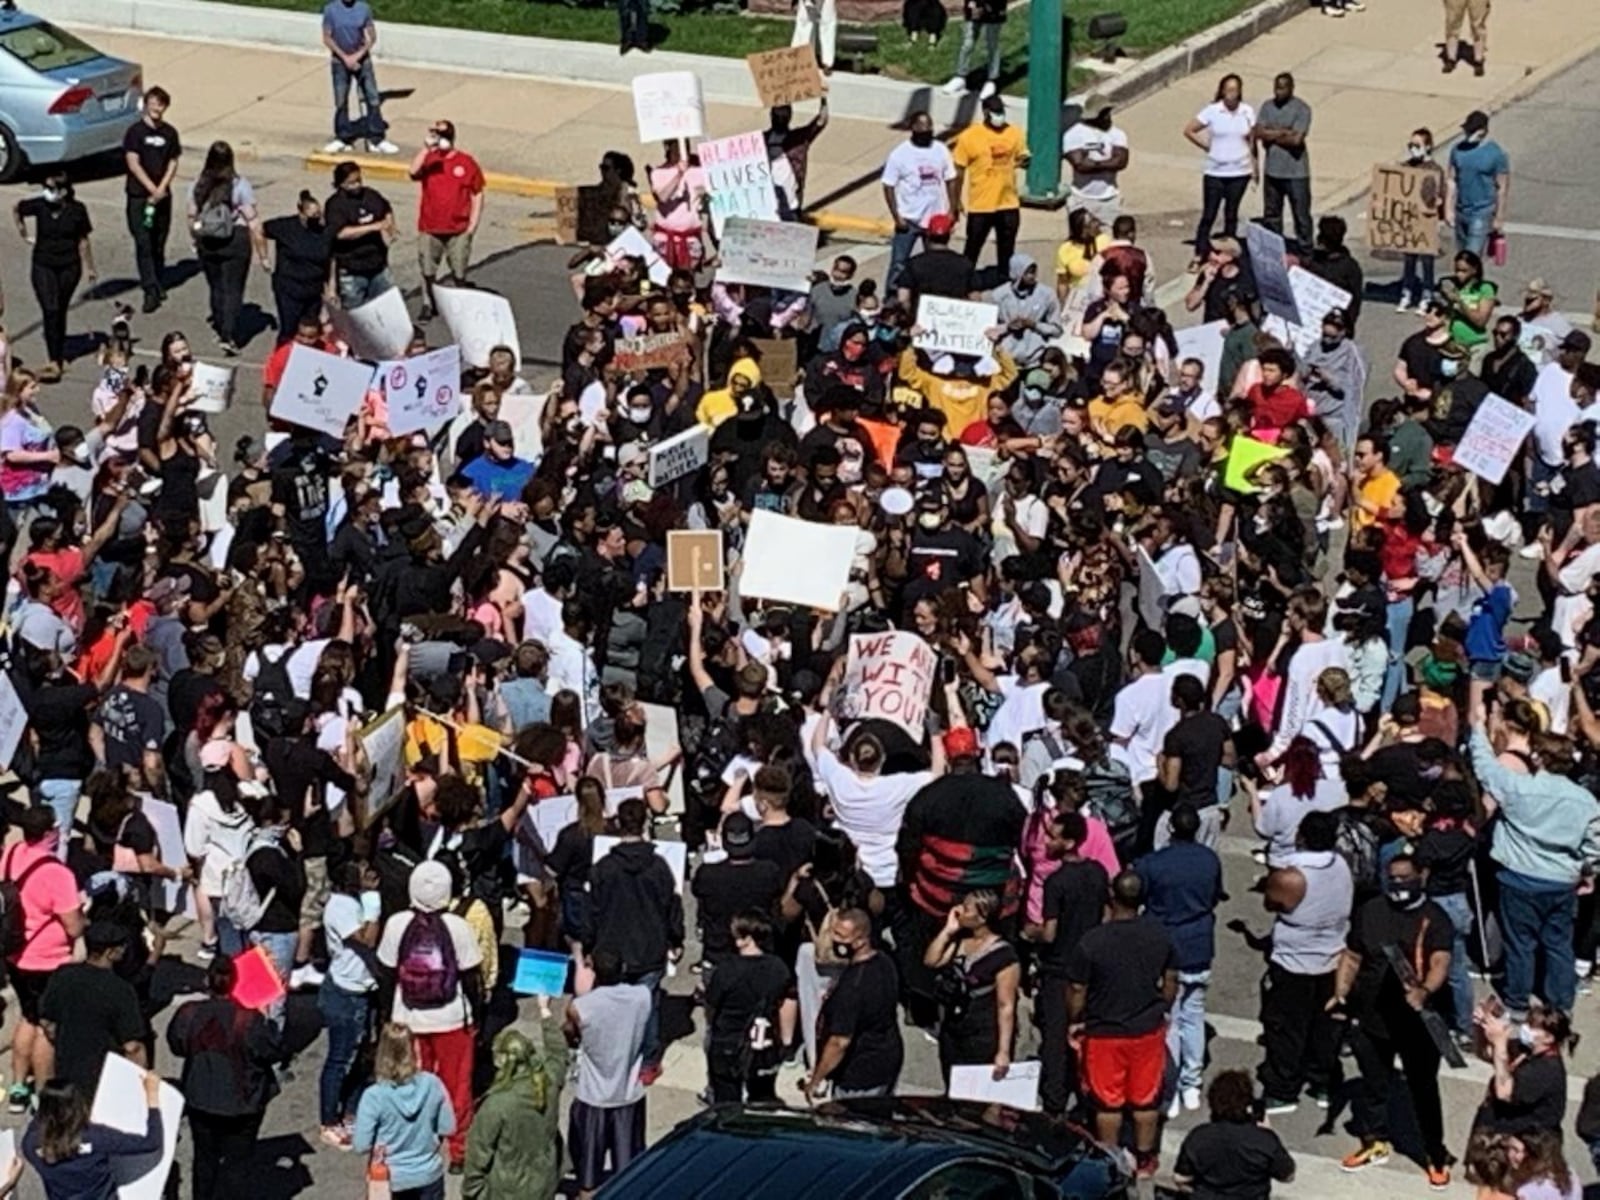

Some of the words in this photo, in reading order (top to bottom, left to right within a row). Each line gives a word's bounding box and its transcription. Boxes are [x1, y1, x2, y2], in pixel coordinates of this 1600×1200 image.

[701, 133, 762, 164] BLACK
[708, 161, 769, 191] LIVES
[1378, 167, 1415, 198] TU
[856, 635, 895, 659] WE
